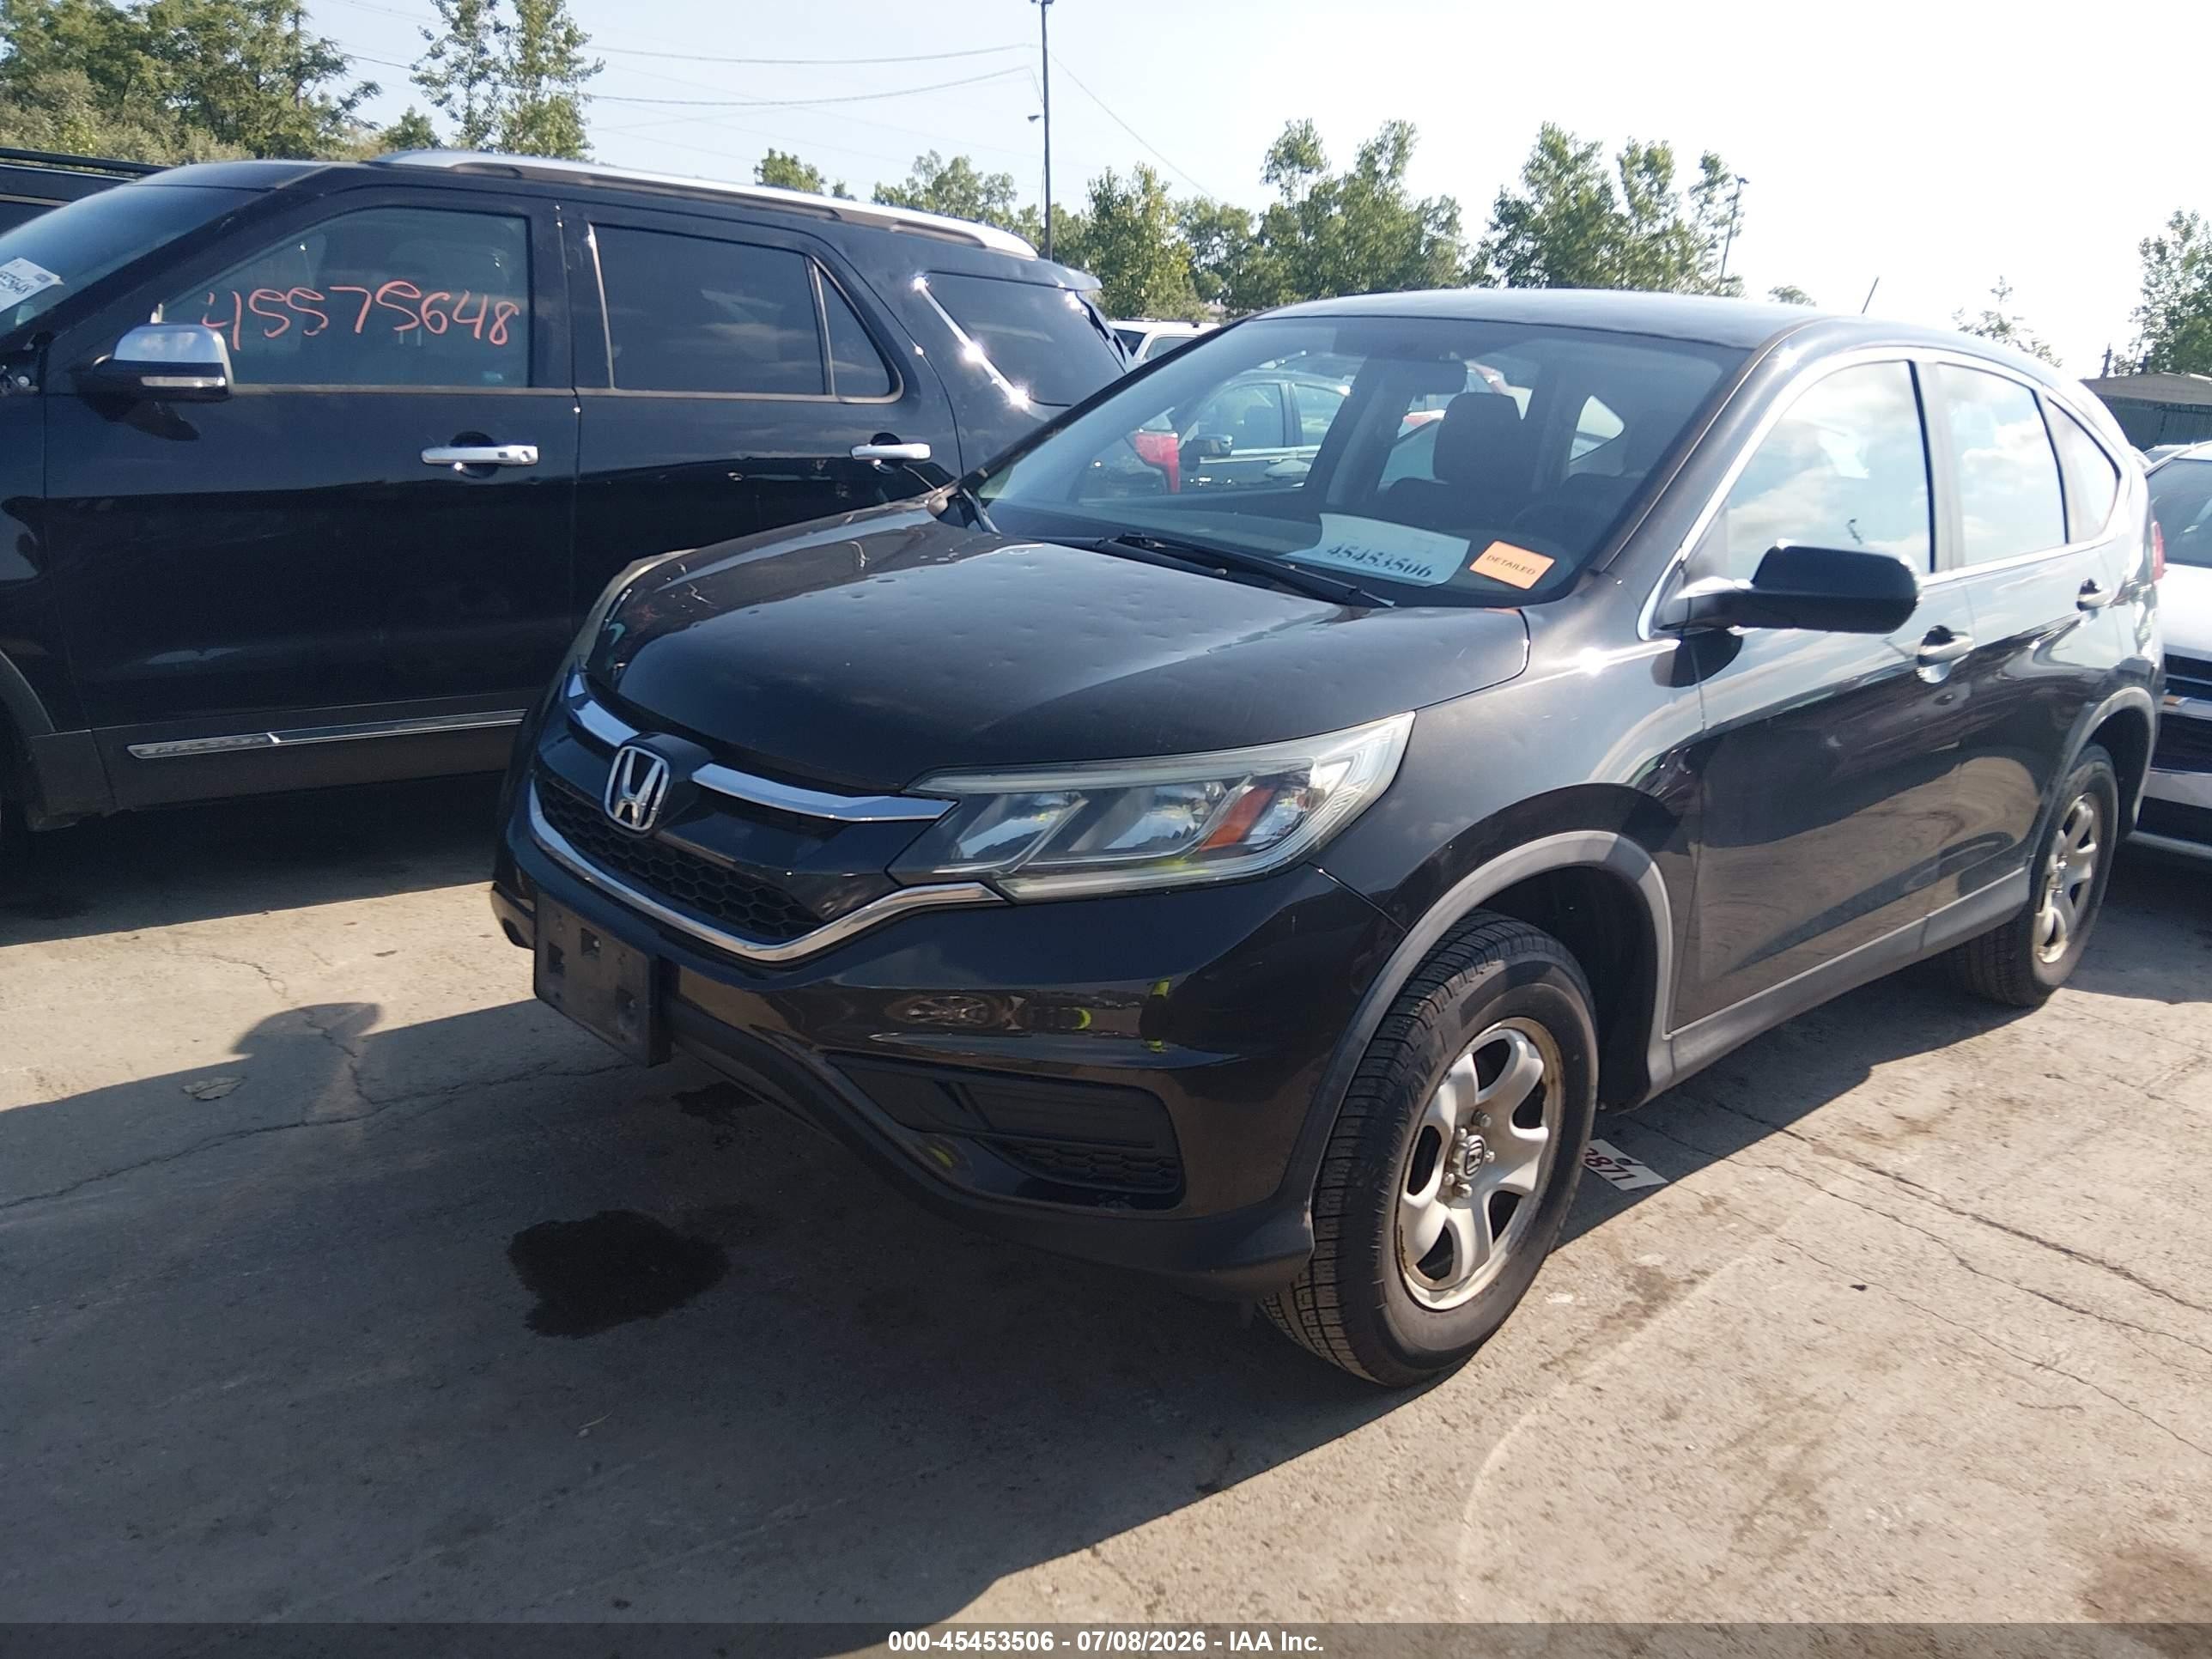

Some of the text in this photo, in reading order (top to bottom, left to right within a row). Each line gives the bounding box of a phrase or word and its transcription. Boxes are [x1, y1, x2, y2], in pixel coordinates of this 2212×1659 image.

[202, 280, 520, 351] 45575648
[1327, 542, 1434, 579] 45453506
[1486, 554, 1536, 576] DETAILED
